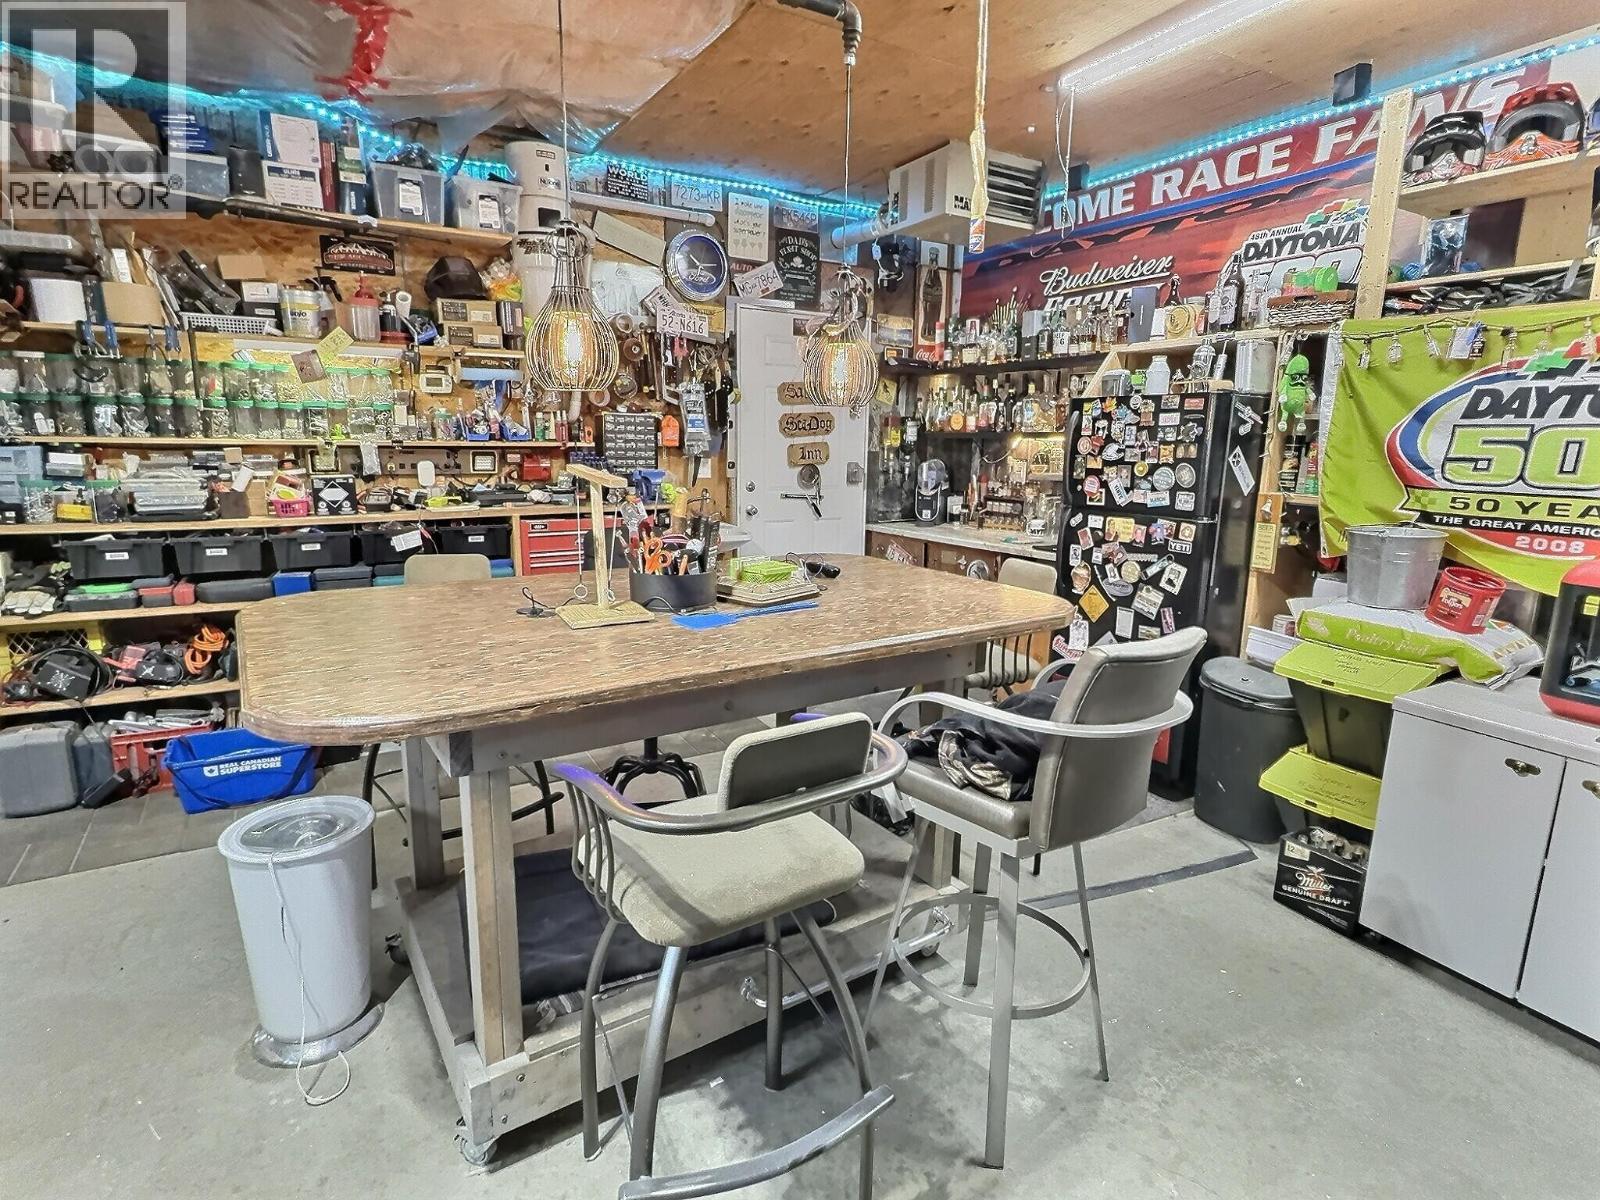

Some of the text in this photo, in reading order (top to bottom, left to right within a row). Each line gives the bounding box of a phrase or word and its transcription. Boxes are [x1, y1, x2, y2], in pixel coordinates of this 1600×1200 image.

[608, 164, 648, 181] WORLD
[1151, 135, 1294, 206] RACE
[1270, 225, 1302, 237] ANNUAL
[1243, 222, 1361, 262] DAYTONA
[688, 270, 710, 283] Ford
[1039, 255, 1174, 296] Budweiser
[799, 447, 822, 461] Inn
[1449, 496, 1501, 513] 50
[1433, 515, 1463, 526] THE
[1469, 518, 1526, 531] GREAT
[1170, 541, 1190, 552] YETI
[1515, 535, 1586, 554] 2008
[219, 756, 282, 769] REAL CANADIAN
[220, 762, 282, 775] SUPERSTORE
[1295, 872, 1334, 891] Miller
[1281, 884, 1350, 906] GENUINE DRAFT
